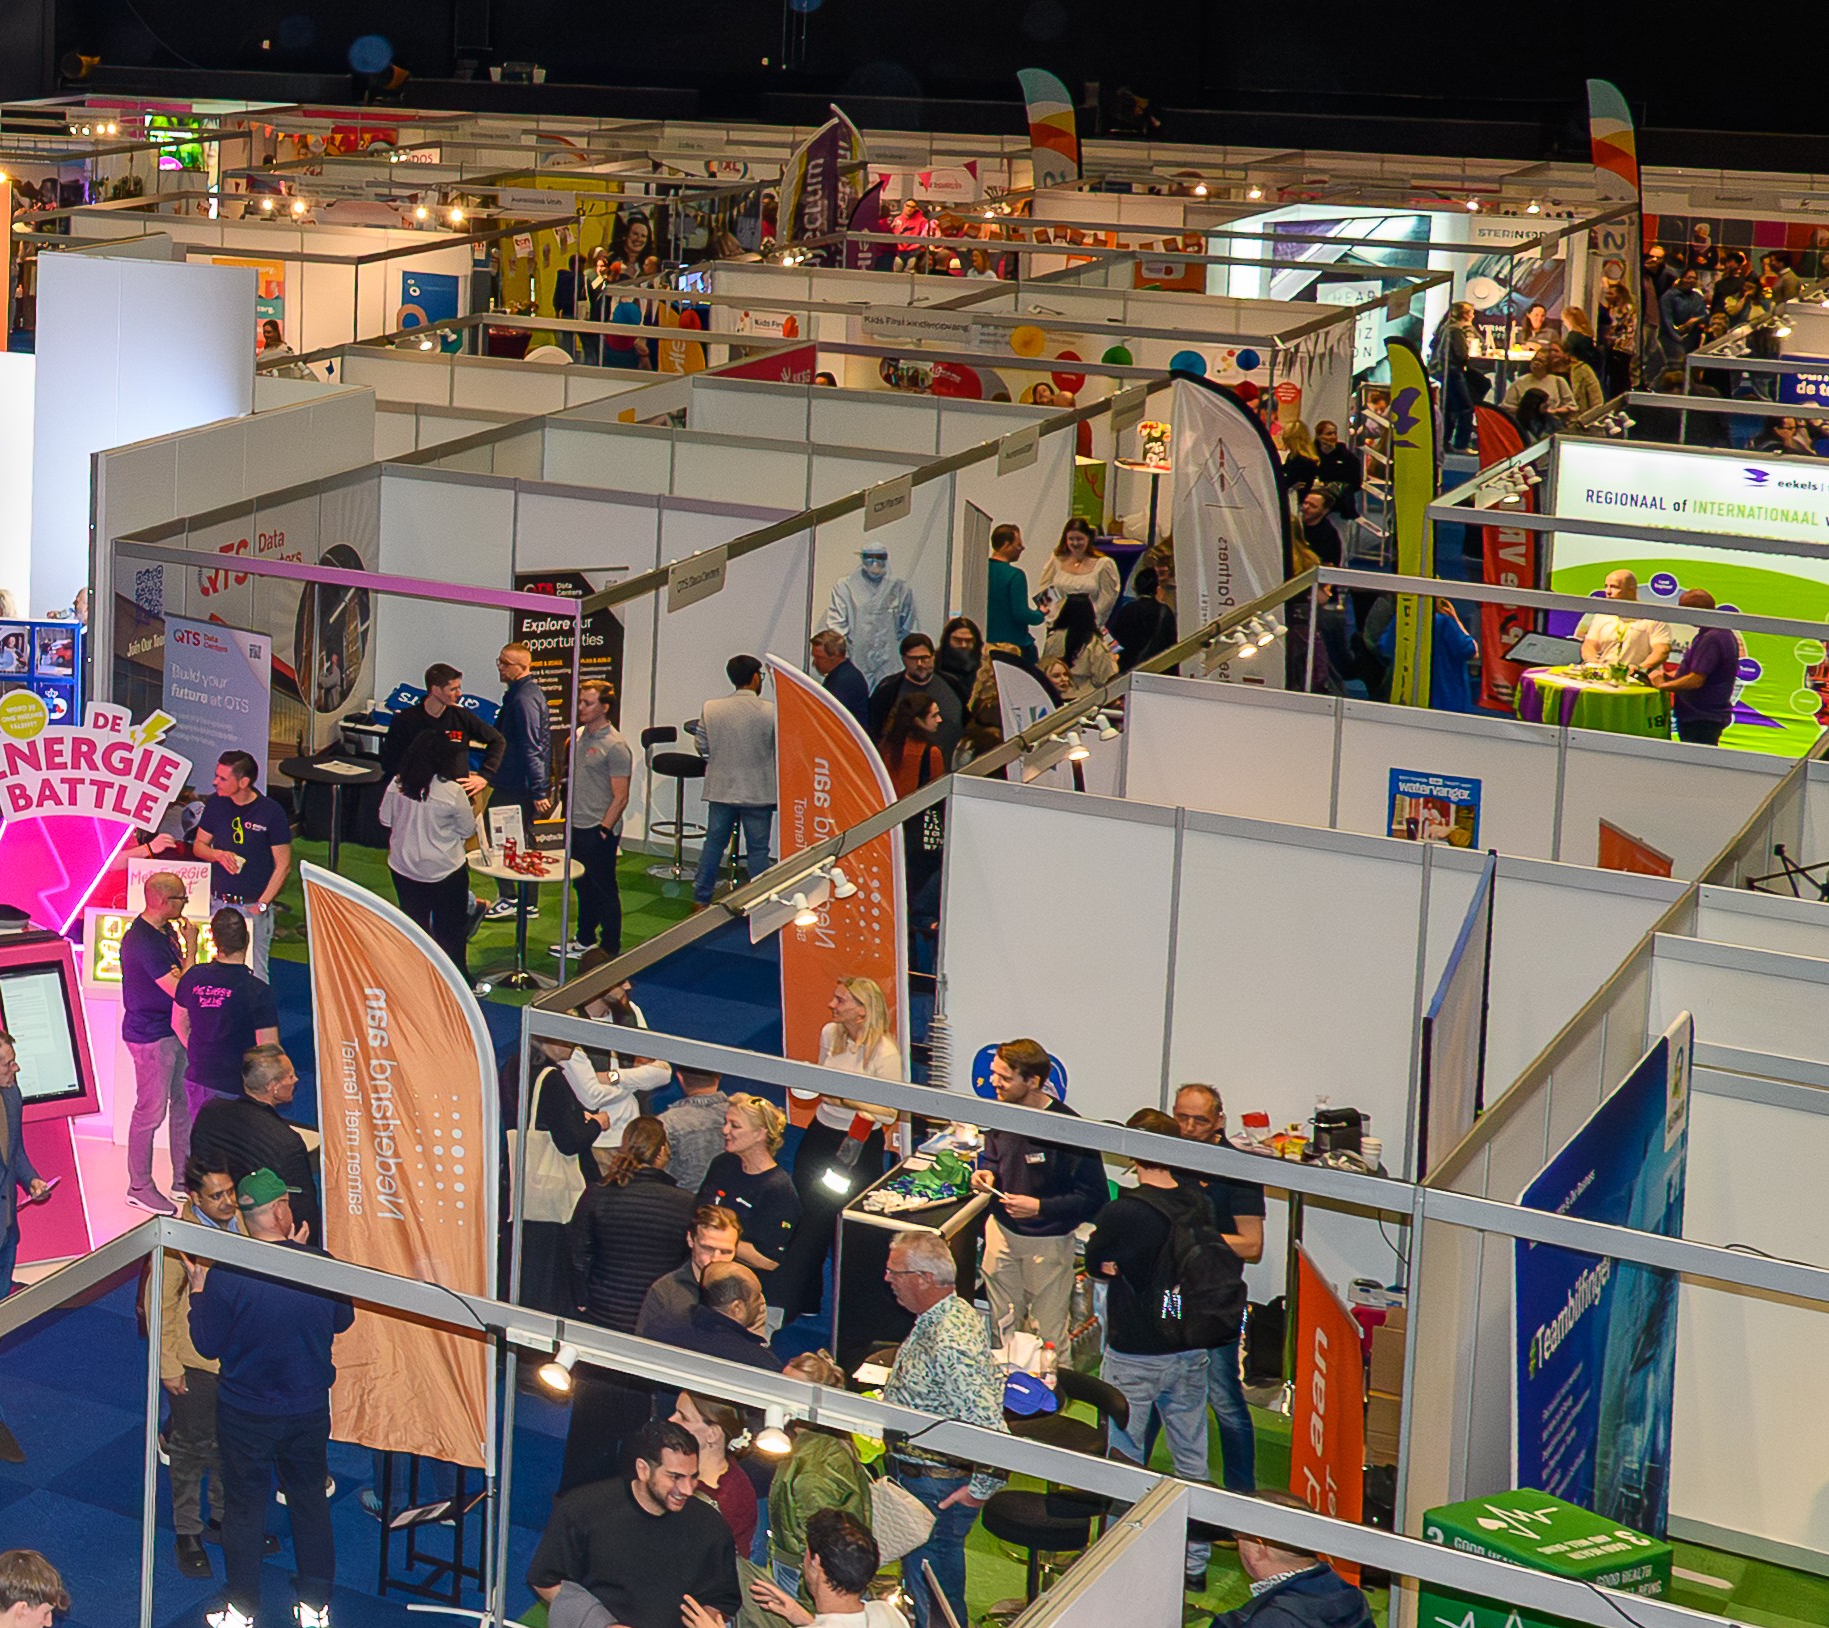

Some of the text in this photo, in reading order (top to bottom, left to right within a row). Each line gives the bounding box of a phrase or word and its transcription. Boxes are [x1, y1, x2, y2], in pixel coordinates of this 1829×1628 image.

[1777, 479, 1819, 492] eekels
[1585, 489, 1819, 527] REGIONAAL of INTERNATIONAAL
[258, 528, 285, 551] Data
[556, 582, 572, 591] Data
[522, 616, 570, 634] Explore
[173, 628, 201, 647] QTS
[170, 662, 229, 692] Build your
[171, 682, 208, 704] future
[93, 711, 123, 734] DE
[8, 774, 162, 825] BATTLE
[1310, 1325, 1330, 1458] aan
